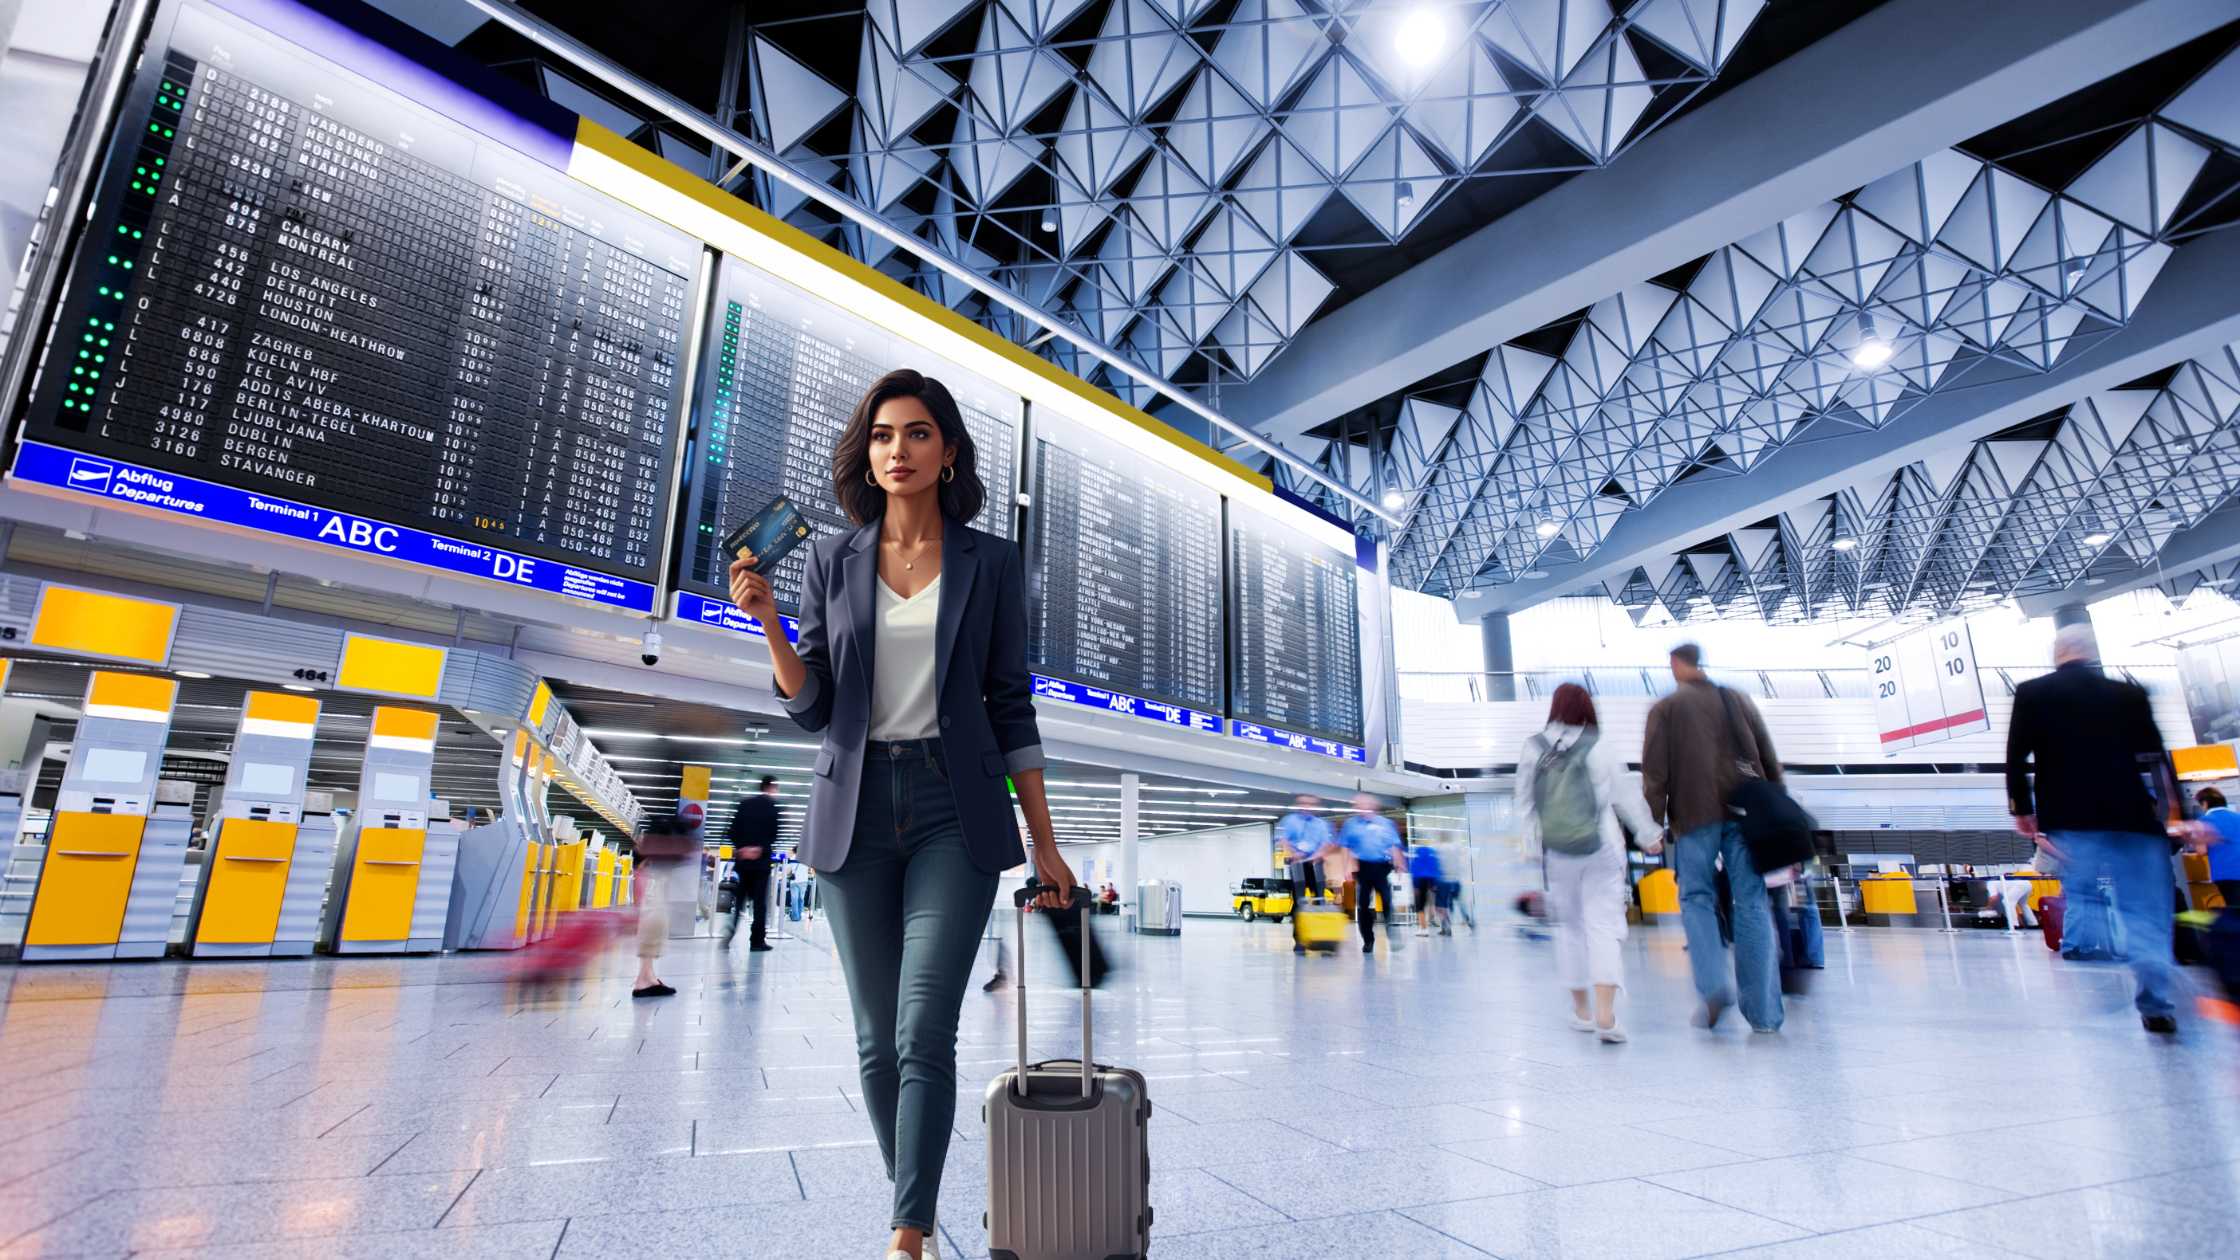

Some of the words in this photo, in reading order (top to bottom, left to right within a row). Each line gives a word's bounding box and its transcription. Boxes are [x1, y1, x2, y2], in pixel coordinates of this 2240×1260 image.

[230, 154, 272, 179] 3236
[225, 213, 257, 234] 875
[277, 233, 355, 271] MONTREAL
[229, 199, 261, 220] 494
[281, 219, 349, 254] CALGARY
[151, 251, 163, 265] L
[208, 271, 242, 291] 440
[262, 289, 333, 322] HOUSTON
[155, 236, 167, 250] L
[212, 256, 246, 277] 442
[266, 275, 336, 308] DETROIT
[217, 242, 249, 263] 456
[270, 261, 300, 281] LOS
[310, 275, 377, 308] ANGELES
[146, 266, 158, 280] L
[193, 282, 238, 306] 4726
[259, 304, 404, 361] LONDON-HEATHROW
[132, 312, 145, 325] L
[180, 327, 226, 350] 6808
[247, 347, 300, 373] KOELN
[310, 366, 339, 385] HBF
[196, 315, 230, 335] 417
[251, 333, 313, 361] ZAGREB
[128, 327, 140, 341] L
[187, 345, 222, 365] 686
[244, 362, 275, 381] TEL
[286, 375, 326, 396] AVIV
[113, 375, 126, 388] J
[174, 391, 210, 411] 117
[232, 407, 326, 443] LJUBLJANA
[118, 359, 131, 372] L
[179, 376, 214, 395] 176
[236, 392, 359, 436] BERLIN-TEGEL
[123, 343, 136, 357] L
[183, 361, 218, 380] 590
[240, 377, 292, 402] ADDIS
[303, 395, 434, 443] ABEBA-KHARTOUM
[103, 407, 117, 421] L
[153, 420, 201, 442] 3126
[224, 438, 289, 464] BERGEN
[108, 391, 122, 404] L
[158, 404, 205, 426] 4980
[228, 422, 292, 449] DUBLIN
[99, 423, 112, 437] L
[149, 436, 197, 458] 3160
[220, 453, 316, 487] STAVANGER
[786, 457, 818, 475] DALLAS
[789, 436, 804, 448] NEW
[810, 444, 829, 457] YORK
[113, 483, 204, 512] Departures
[117, 468, 173, 492] Abflug
[784, 478, 820, 497] DETROIT
[785, 468, 822, 487] CHICAGO
[248, 497, 309, 520] Terminal
[313, 512, 318, 522] 1
[318, 517, 399, 552] ABC
[431, 538, 480, 560] Terminal
[482, 551, 491, 562] 2
[493, 554, 535, 583] DE
[1940, 631, 1959, 650] 10
[293, 668, 328, 683] 464
[1874, 655, 1892, 674] 20
[1945, 657, 1964, 676] 10
[1109, 694, 1135, 714] ABC
[1879, 680, 1896, 698] 20
[1165, 707, 1180, 724] DE
[1288, 734, 1307, 749] ABC
[1326, 743, 1337, 756] DE
